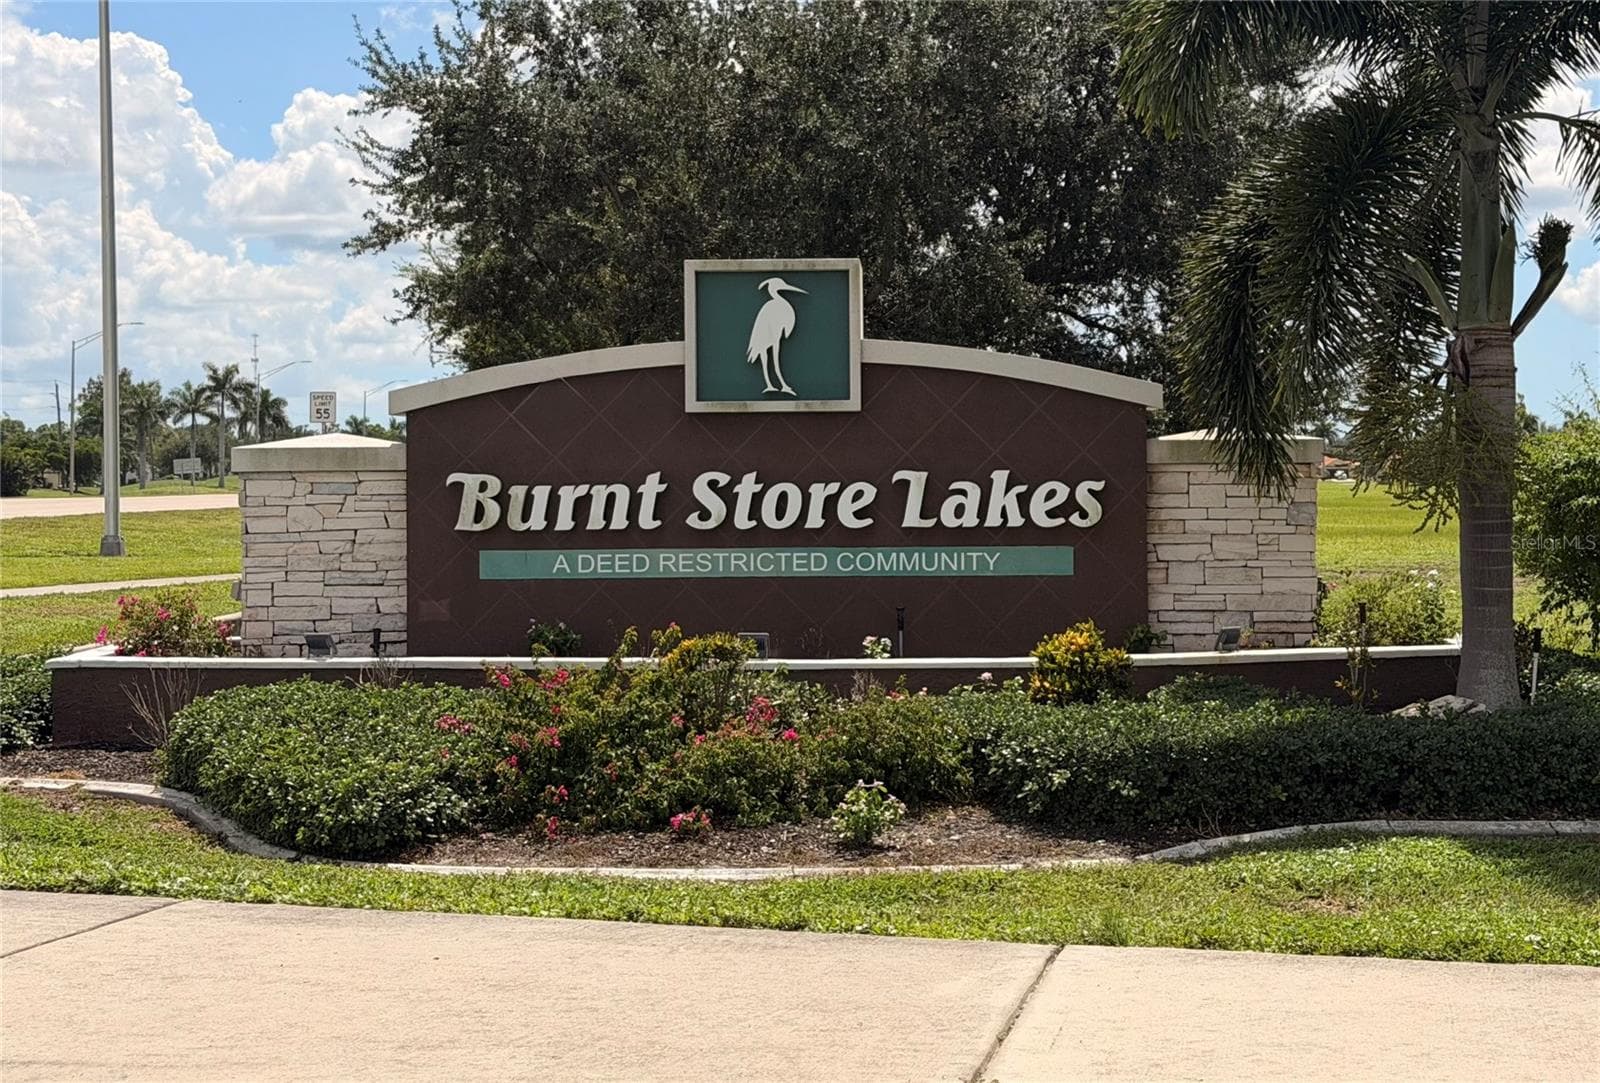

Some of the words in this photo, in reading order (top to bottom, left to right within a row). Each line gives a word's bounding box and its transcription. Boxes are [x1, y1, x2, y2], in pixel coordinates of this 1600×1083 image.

[316, 408, 330, 419] 55
[446, 471, 668, 532] Burnt
[685, 471, 878, 530] Store
[892, 469, 1106, 529] Lakes
[552, 554, 571, 573] A
[577, 553, 650, 573] DEED
[658, 552, 828, 573] RESTRICTED
[836, 551, 1001, 571] COMMUNITY
